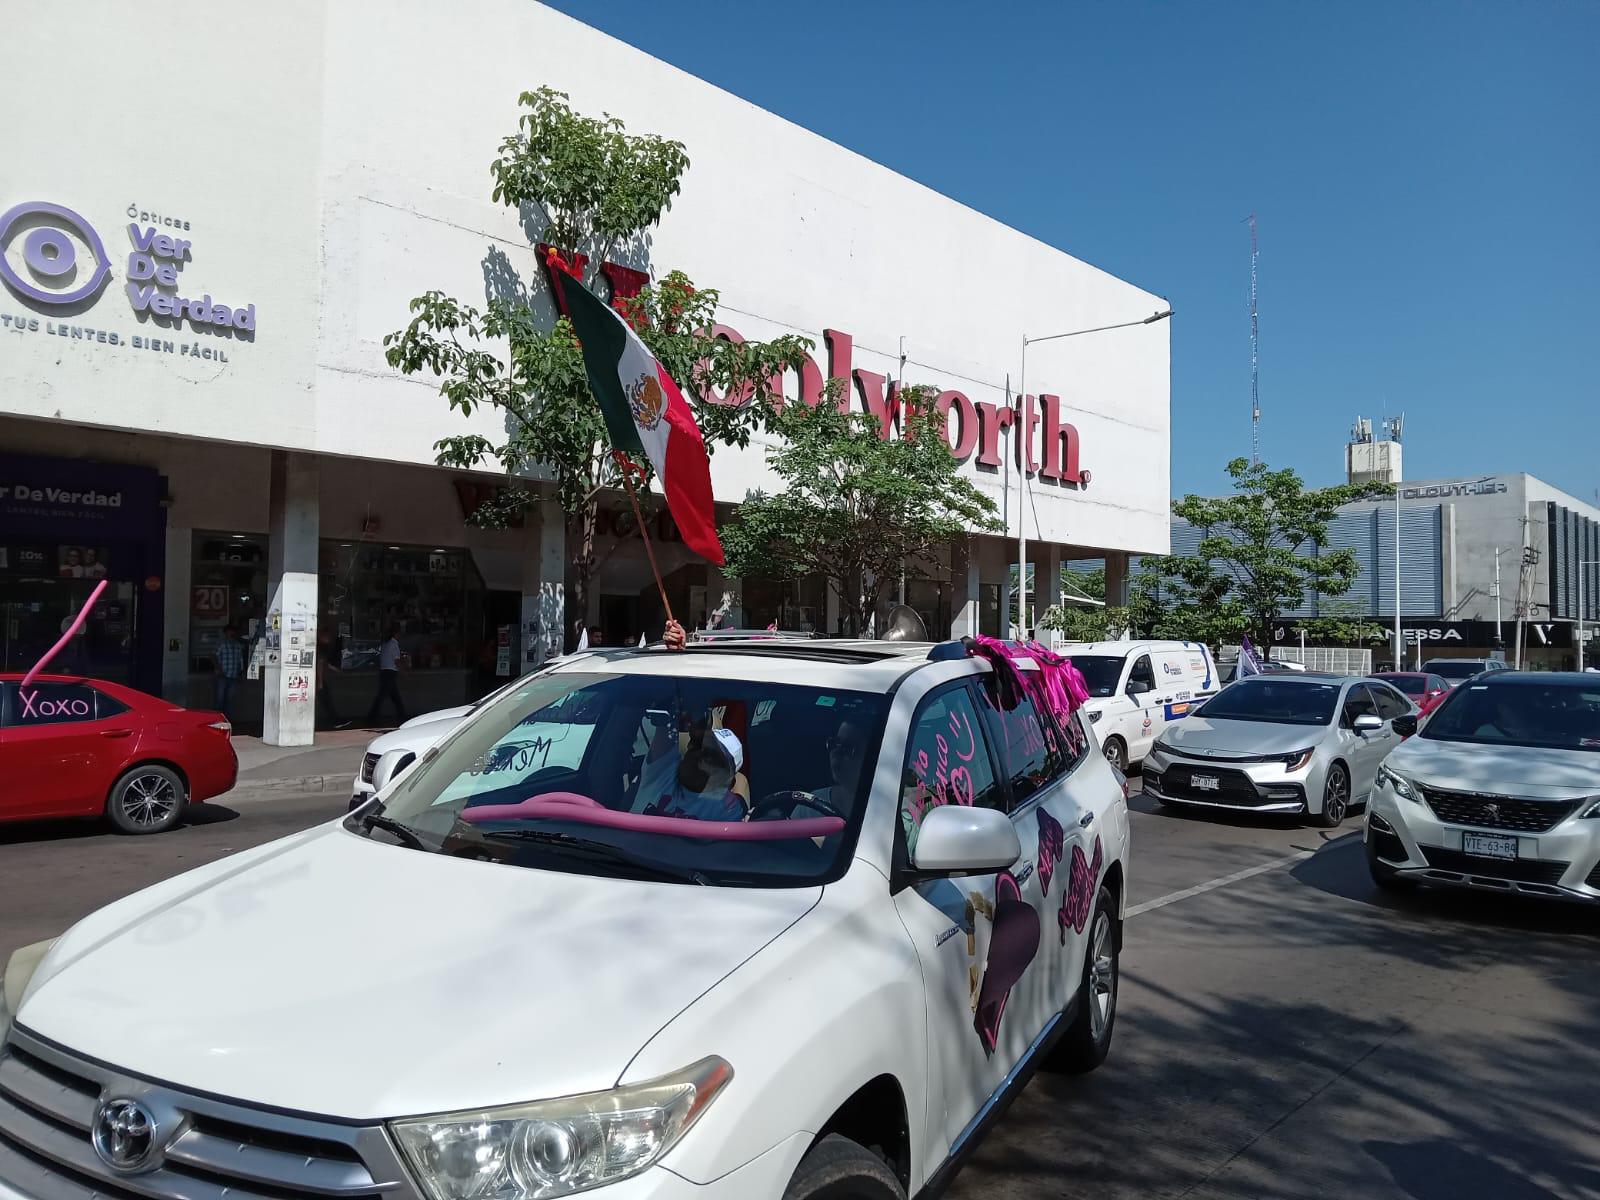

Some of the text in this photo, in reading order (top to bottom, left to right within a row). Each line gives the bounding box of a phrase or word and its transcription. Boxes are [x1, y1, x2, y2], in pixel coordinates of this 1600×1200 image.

[127, 203, 191, 231] Ópticas
[127, 222, 192, 260] Ver
[128, 251, 178, 286] De
[127, 283, 256, 332] Verdad
[1, 315, 229, 363] TUS LENTES, BIEN FÁCIL
[14, 485, 43, 502] De
[45, 487, 122, 507] Verdad
[195, 588, 225, 610] 20
[1367, 628, 1463, 641] ANESSA
